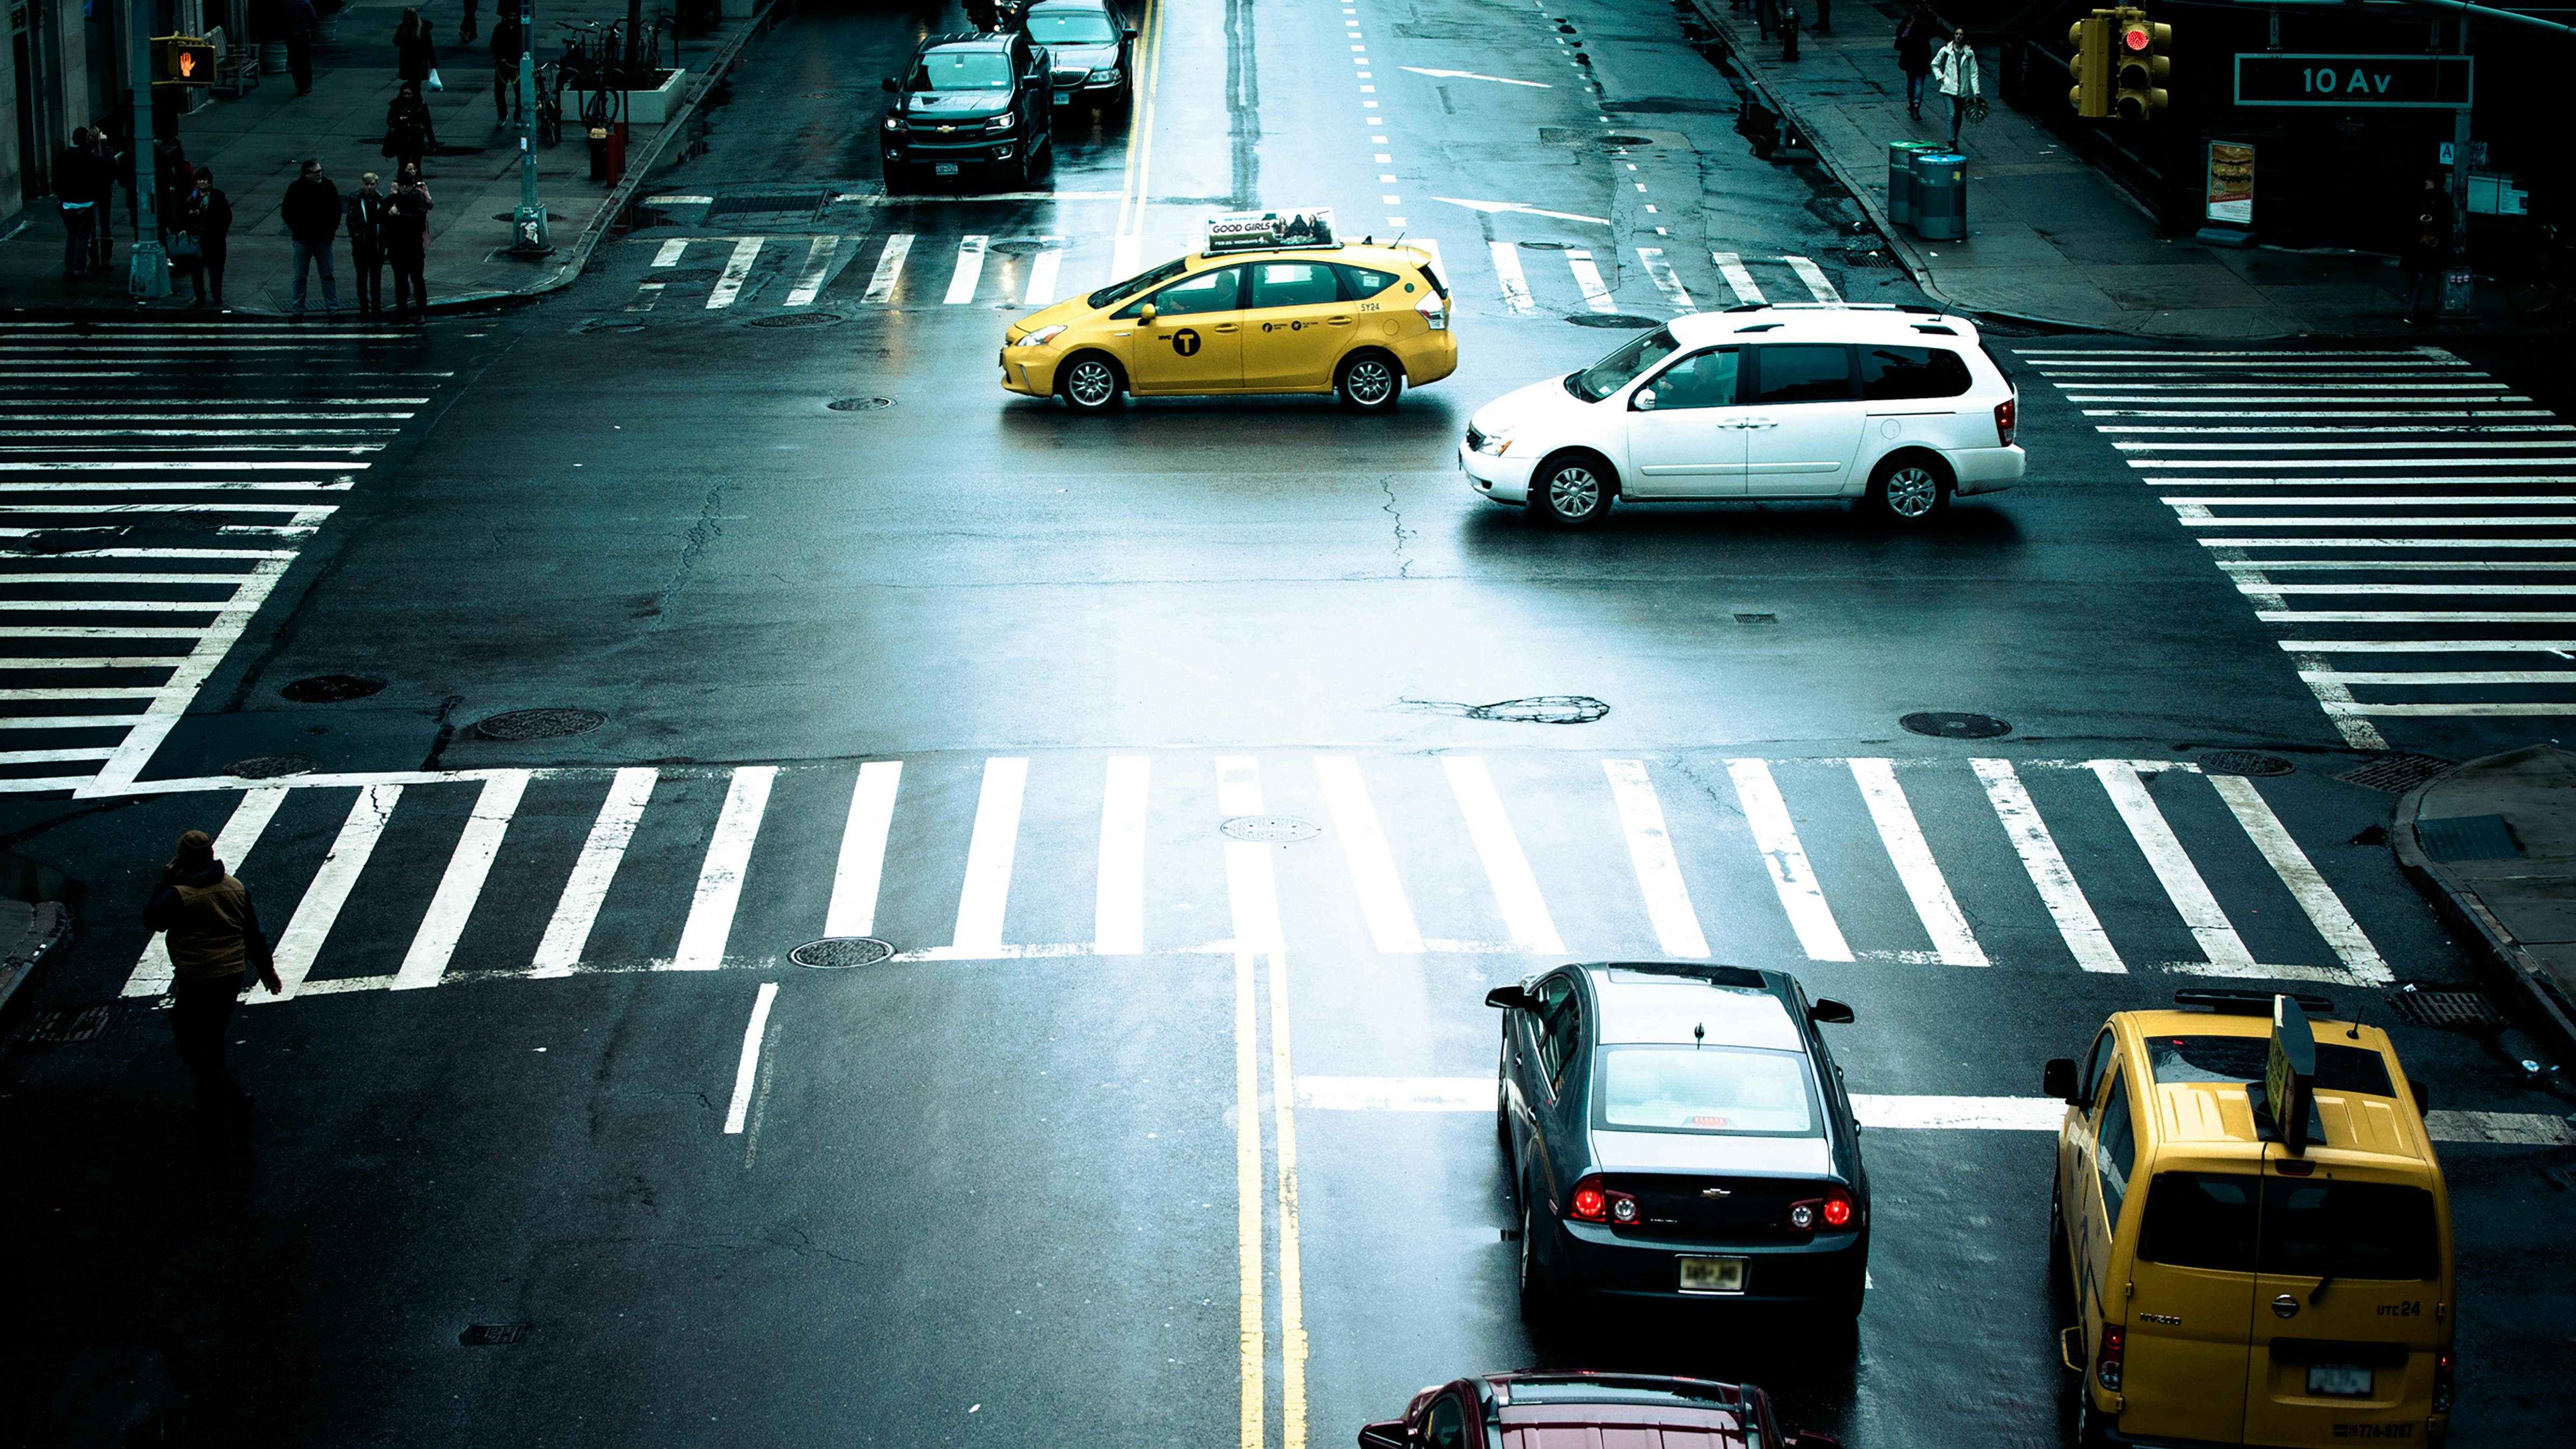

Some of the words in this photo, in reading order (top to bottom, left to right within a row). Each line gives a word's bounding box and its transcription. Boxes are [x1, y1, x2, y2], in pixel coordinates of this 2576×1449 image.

[2303, 68, 2337, 93] 10
[2346, 68, 2392, 93] Av
[2442, 145, 2451, 158] A
[1213, 224, 1242, 233] GOOD
[1245, 222, 1270, 231] GIRLS
[1179, 334, 1195, 353] T
